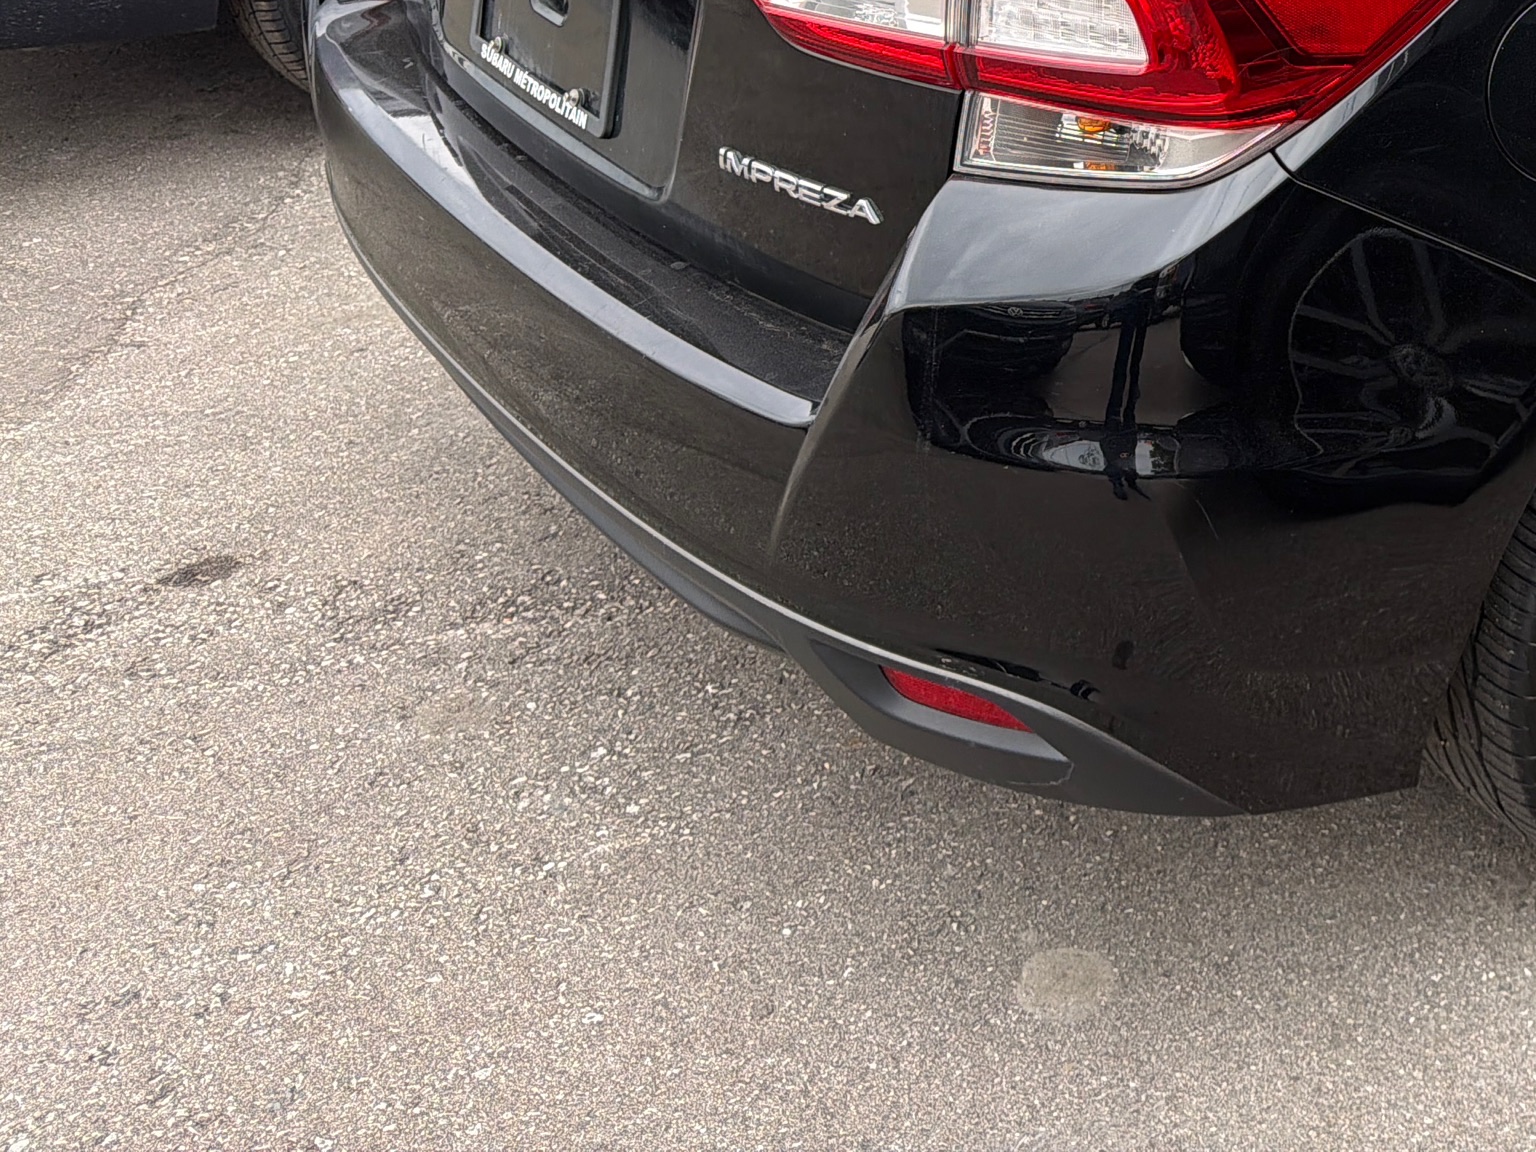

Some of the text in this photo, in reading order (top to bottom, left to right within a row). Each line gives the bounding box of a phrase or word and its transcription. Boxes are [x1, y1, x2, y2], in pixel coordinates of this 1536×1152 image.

[480, 43, 588, 130] SUBARU MÉTROPOLITAIN
[718, 146, 884, 226] IMPREZA
